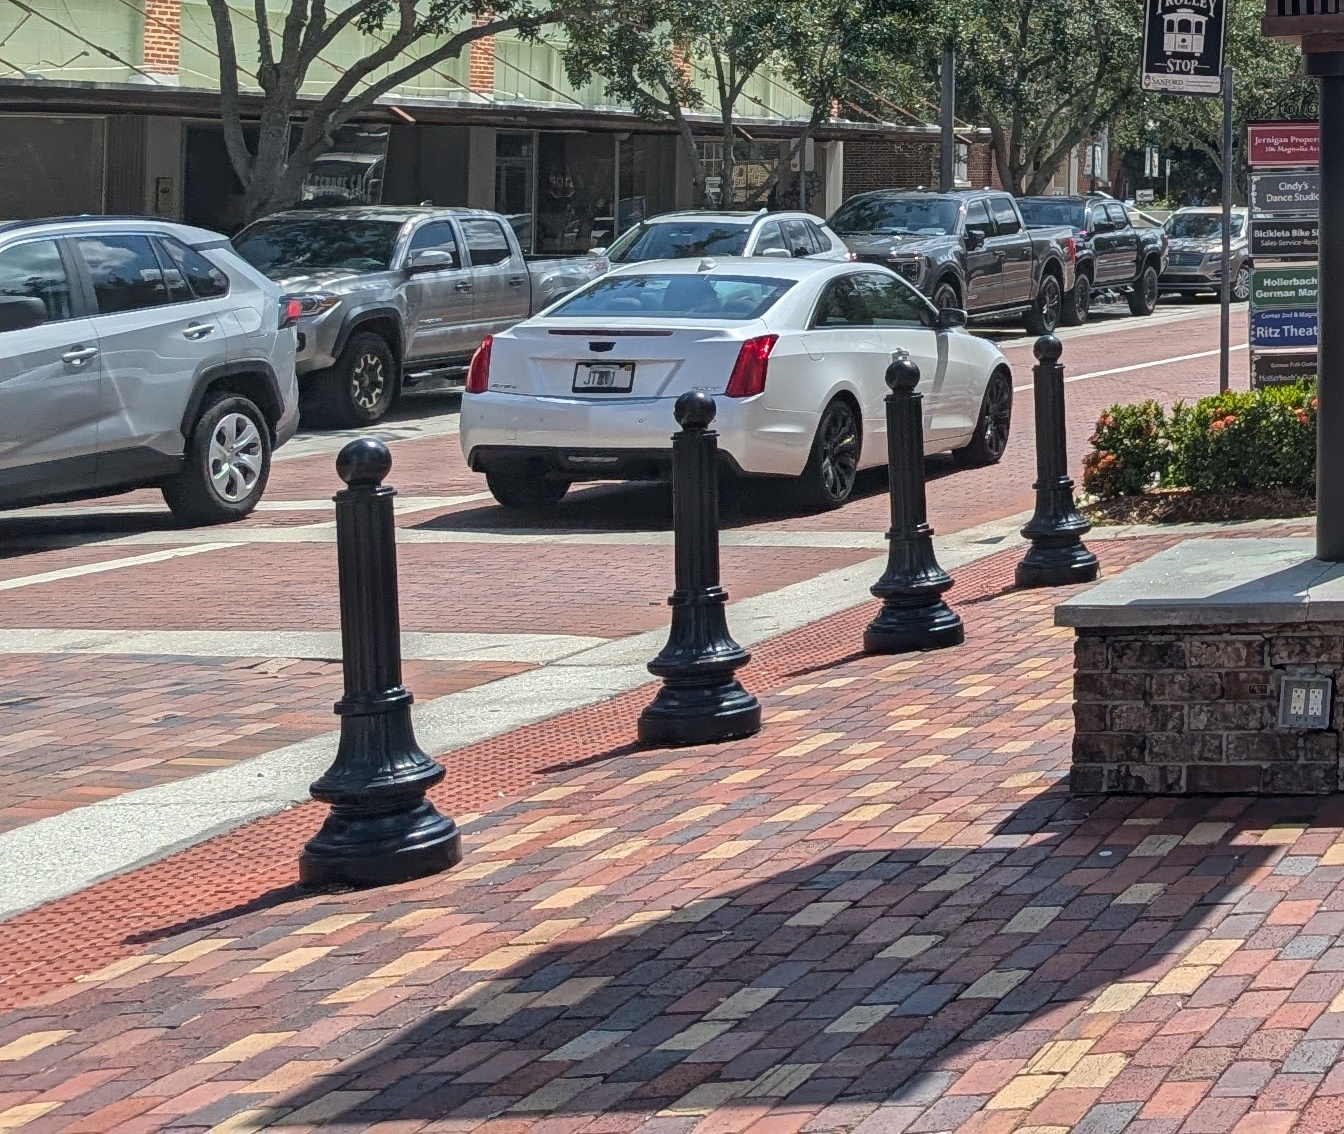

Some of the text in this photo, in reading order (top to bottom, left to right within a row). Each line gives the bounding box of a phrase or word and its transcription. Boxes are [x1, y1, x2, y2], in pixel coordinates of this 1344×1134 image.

[1166, 58, 1199, 74] STOP
[1254, 136, 1289, 146] Jernigan
[1278, 181, 1309, 191] Cindy's
[1266, 193, 1293, 203] Dance
[1291, 228, 1310, 237] Bike
[1263, 277, 1318, 287] Hollerbach
[1255, 289, 1296, 298] German
[1256, 326, 1281, 338] Ritz
